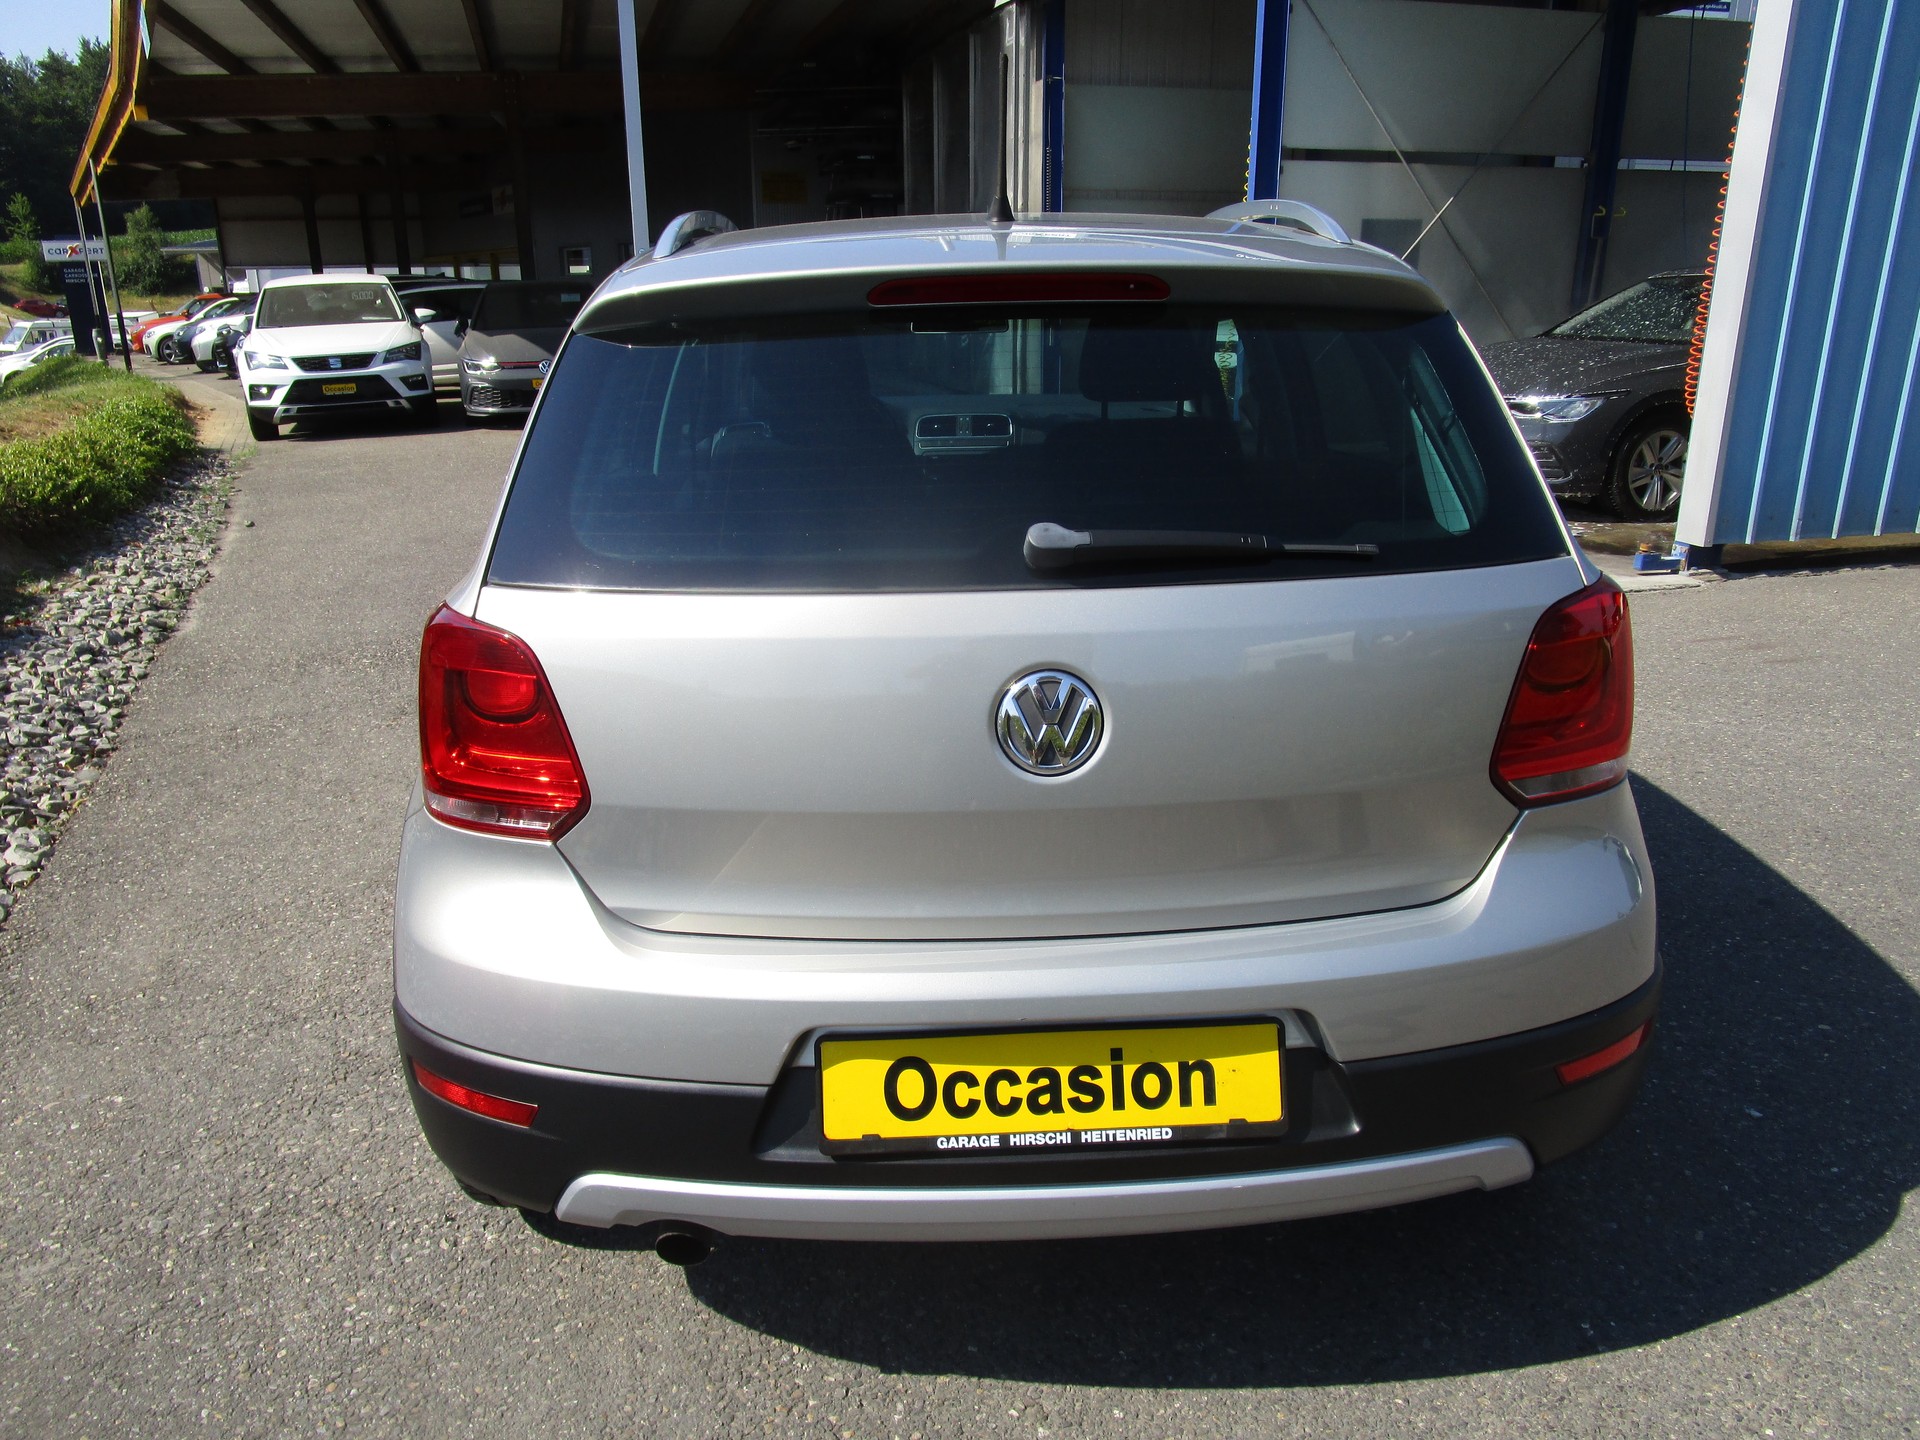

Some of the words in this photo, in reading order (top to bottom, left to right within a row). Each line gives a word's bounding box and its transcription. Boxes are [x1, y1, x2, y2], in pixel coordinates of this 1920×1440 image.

[884, 1047, 1217, 1122] Occasion
[936, 1135, 1000, 1149] GARAGE
[1009, 1131, 1072, 1146] HIRSCHI
[1080, 1127, 1173, 1143] HEITENRIED
